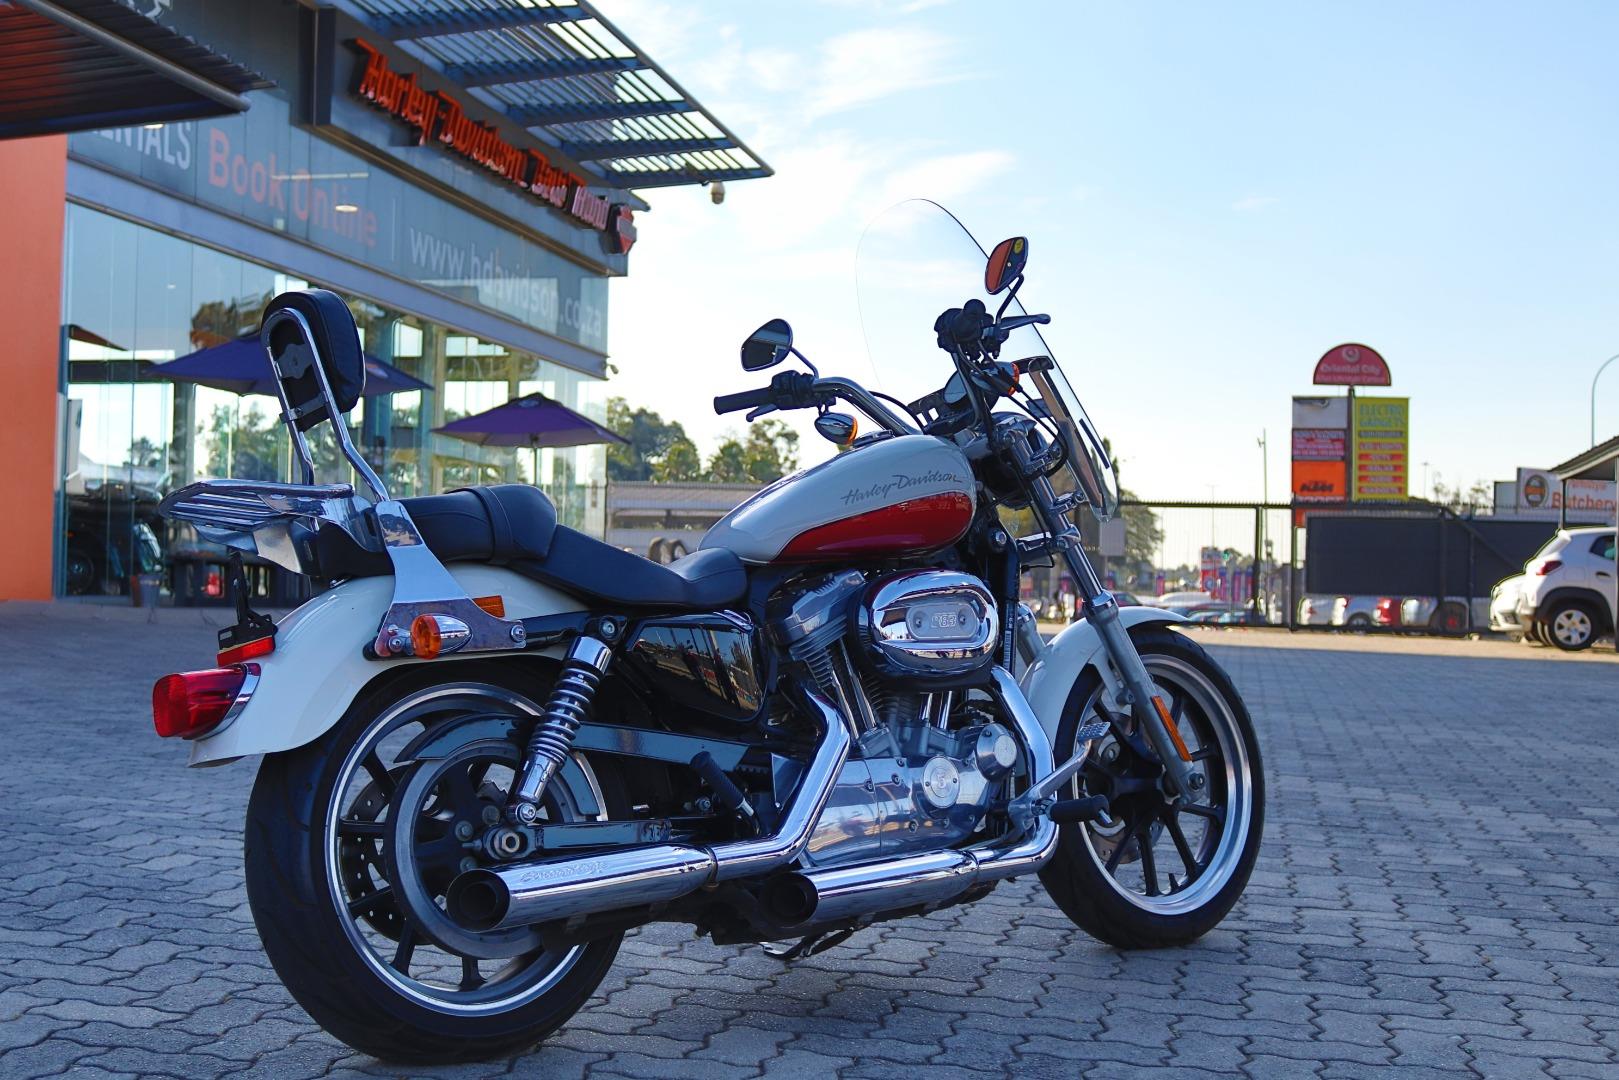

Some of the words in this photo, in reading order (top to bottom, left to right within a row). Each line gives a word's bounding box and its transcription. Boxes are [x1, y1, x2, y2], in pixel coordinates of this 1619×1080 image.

[356, 37, 529, 188] Harley-Davidson
[209, 127, 286, 211] Book
[292, 168, 378, 248] Online
[840, 470, 962, 505] Harley-Davidson
